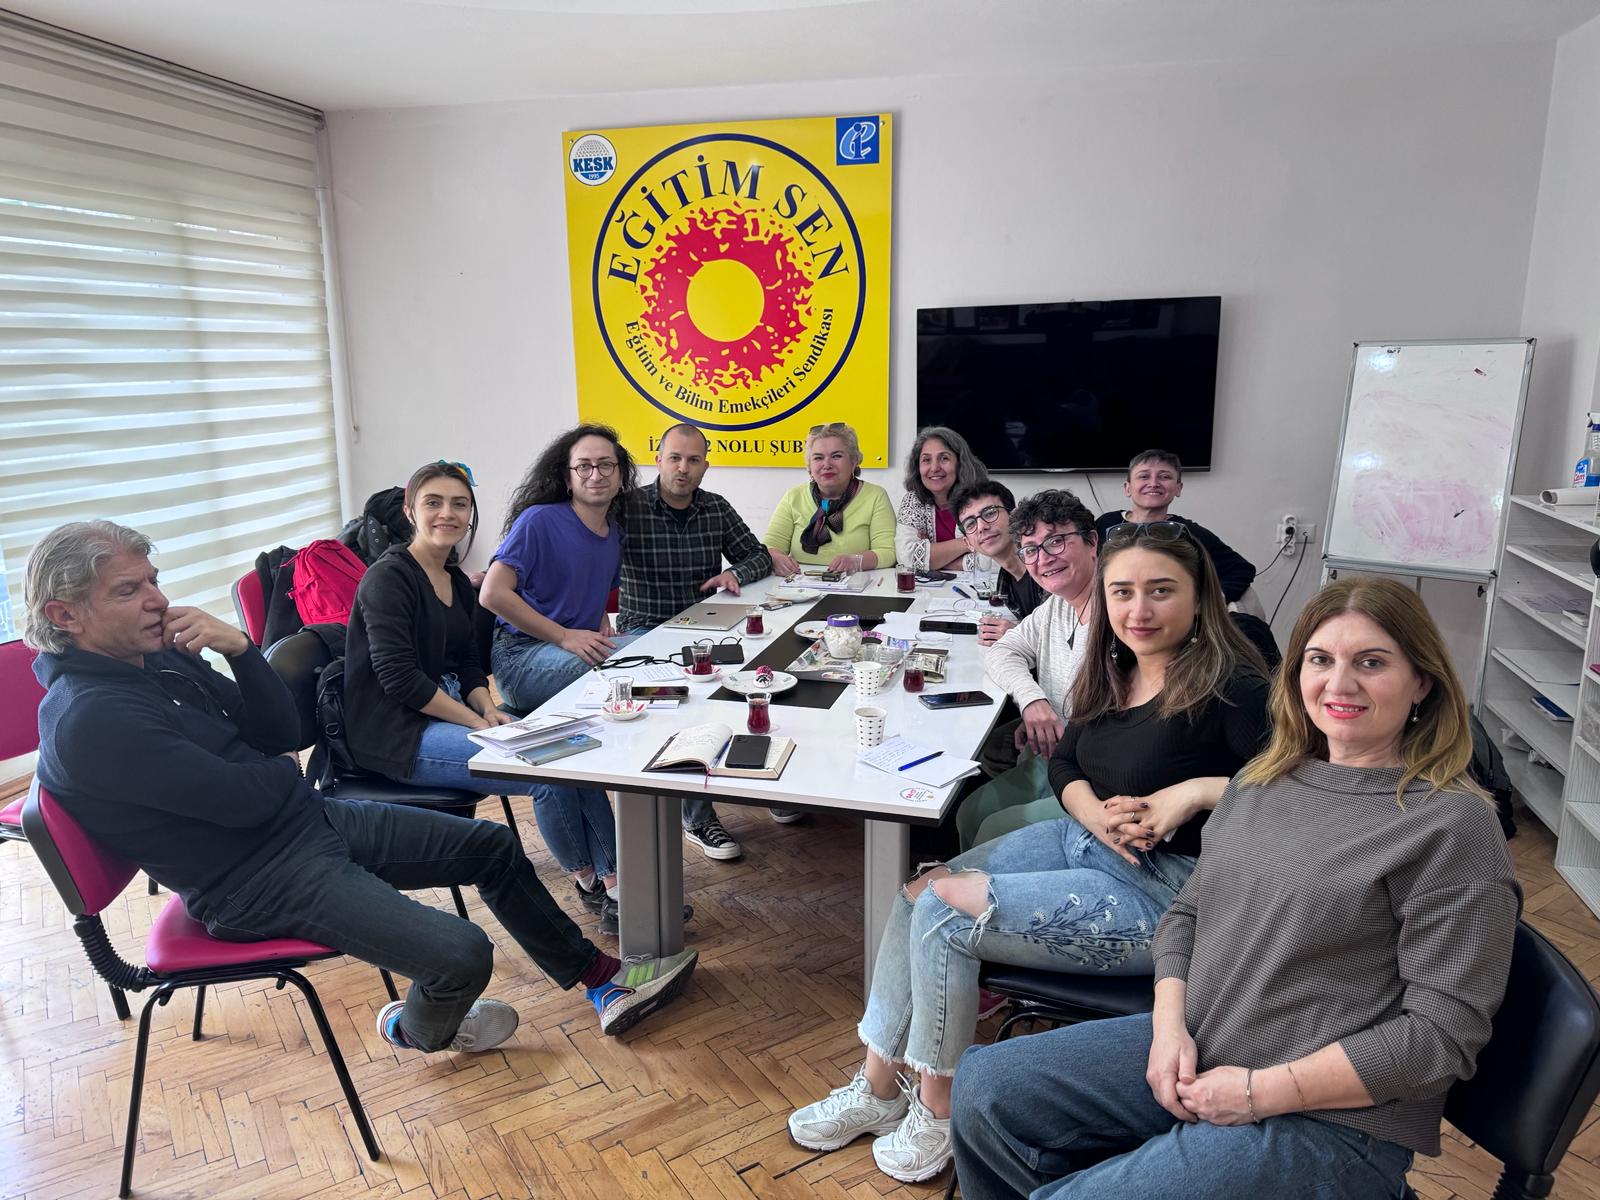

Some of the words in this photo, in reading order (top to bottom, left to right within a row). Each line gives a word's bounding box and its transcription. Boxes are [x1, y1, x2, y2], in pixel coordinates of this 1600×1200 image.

[573, 156, 614, 172] KESK
[607, 154, 765, 287] EĞİTİM
[773, 183, 850, 281] SEN
[625, 320, 659, 376] Eğitim
[658, 377, 673, 391] ve
[674, 384, 714, 412] Bilim
[718, 377, 796, 413] Emekçileri
[792, 308, 834, 382] Sendikası
[717, 439, 765, 454] NOLU
[769, 439, 807, 456] ŞUB
